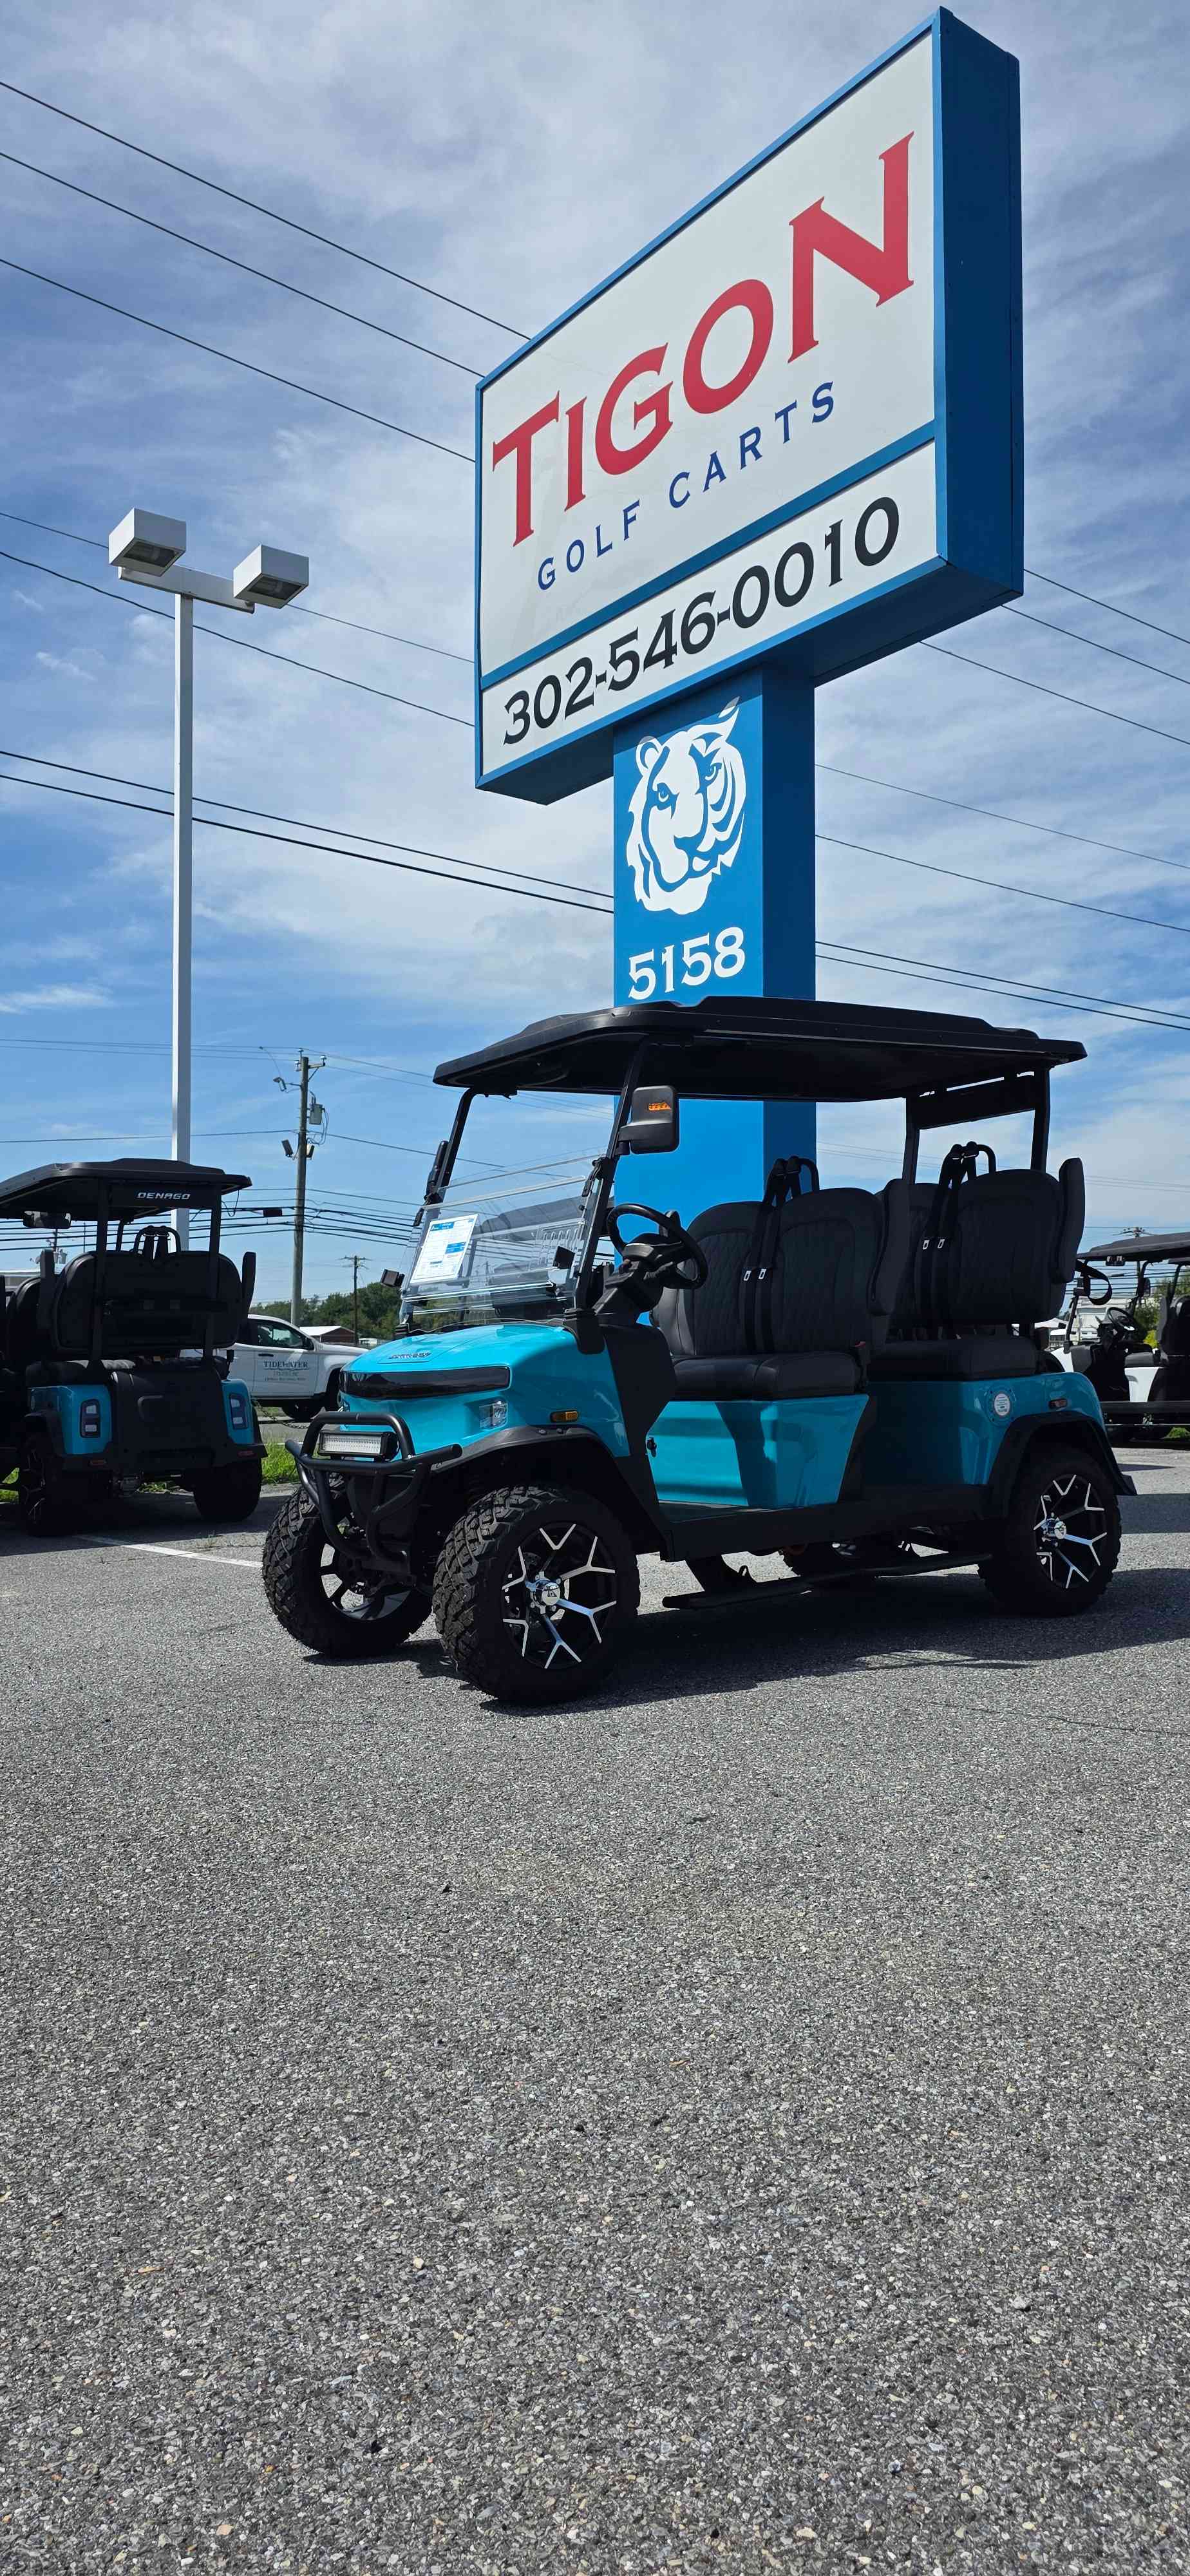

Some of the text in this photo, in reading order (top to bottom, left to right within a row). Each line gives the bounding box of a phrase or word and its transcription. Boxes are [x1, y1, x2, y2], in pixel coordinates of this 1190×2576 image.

[493, 131, 914, 547] TIGON
[538, 381, 834, 591] GOLF CARTS
[503, 497, 900, 746] 302-546-0010
[628, 926, 746, 1000] 5158
